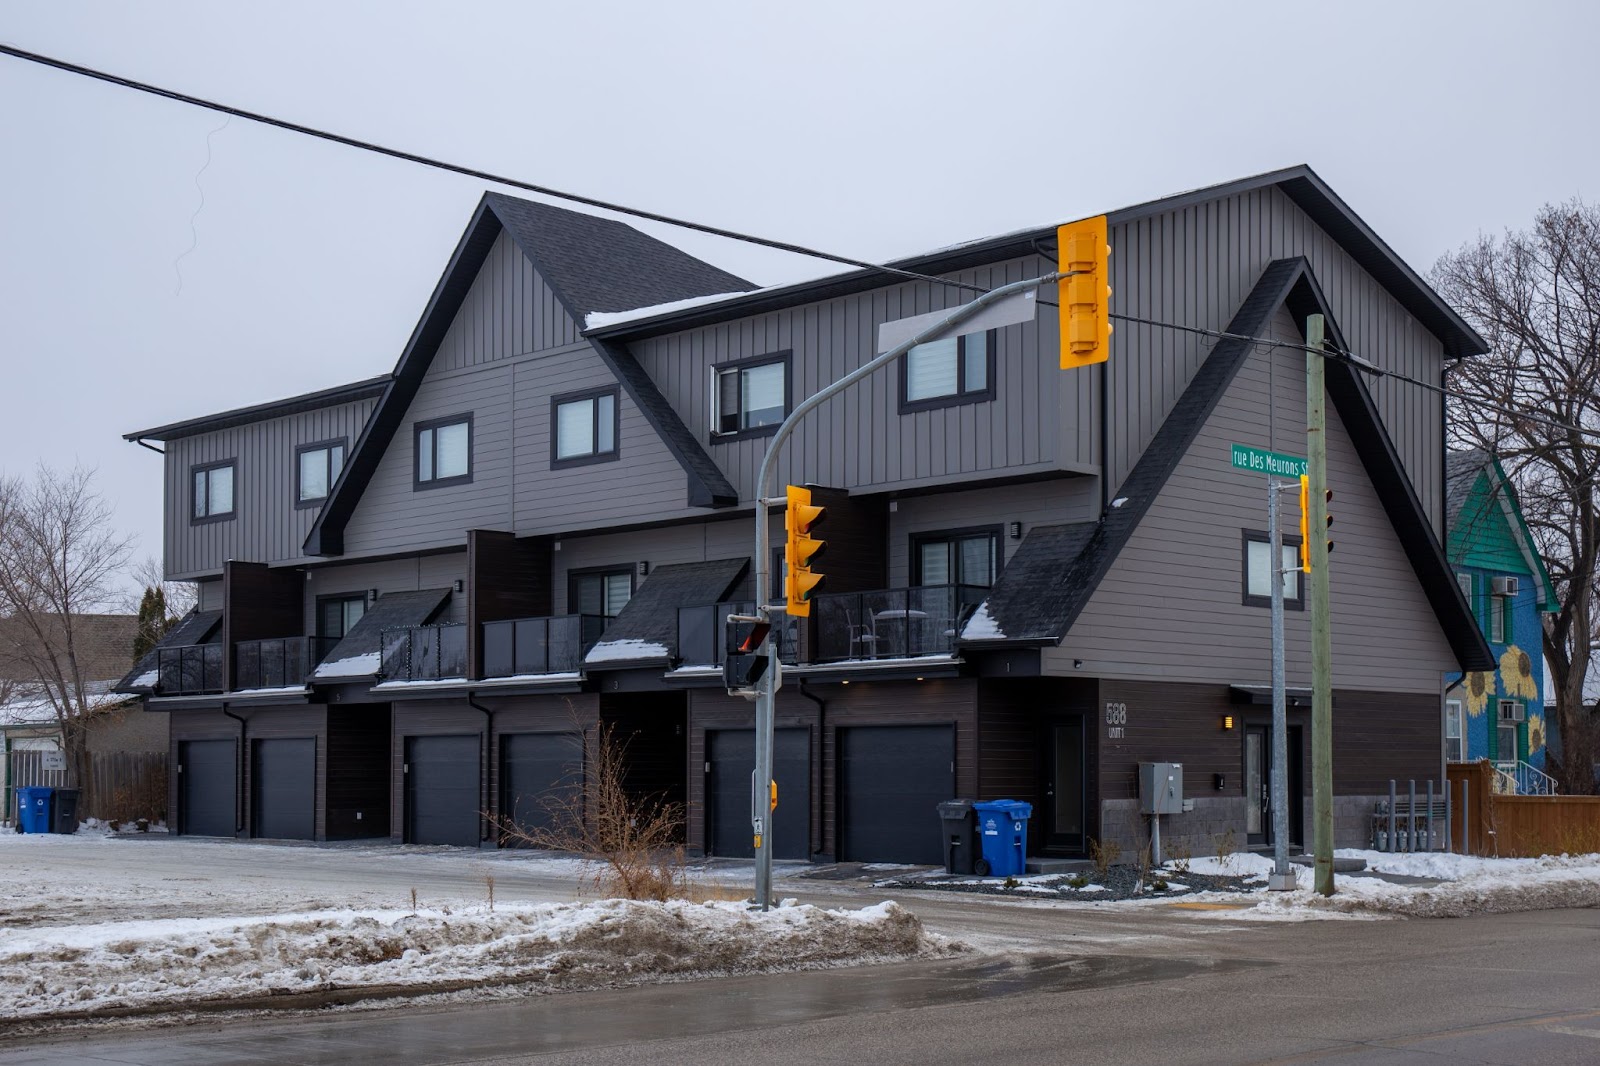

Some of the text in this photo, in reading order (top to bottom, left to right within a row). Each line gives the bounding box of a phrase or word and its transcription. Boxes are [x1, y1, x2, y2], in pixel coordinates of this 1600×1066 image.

[1234, 451, 1247, 466] rue
[1249, 451, 1264, 469] Des
[1266, 454, 1299, 476] Meurons
[1106, 702, 1127, 724] 588
[1108, 727, 1125, 739] UNIT 1
